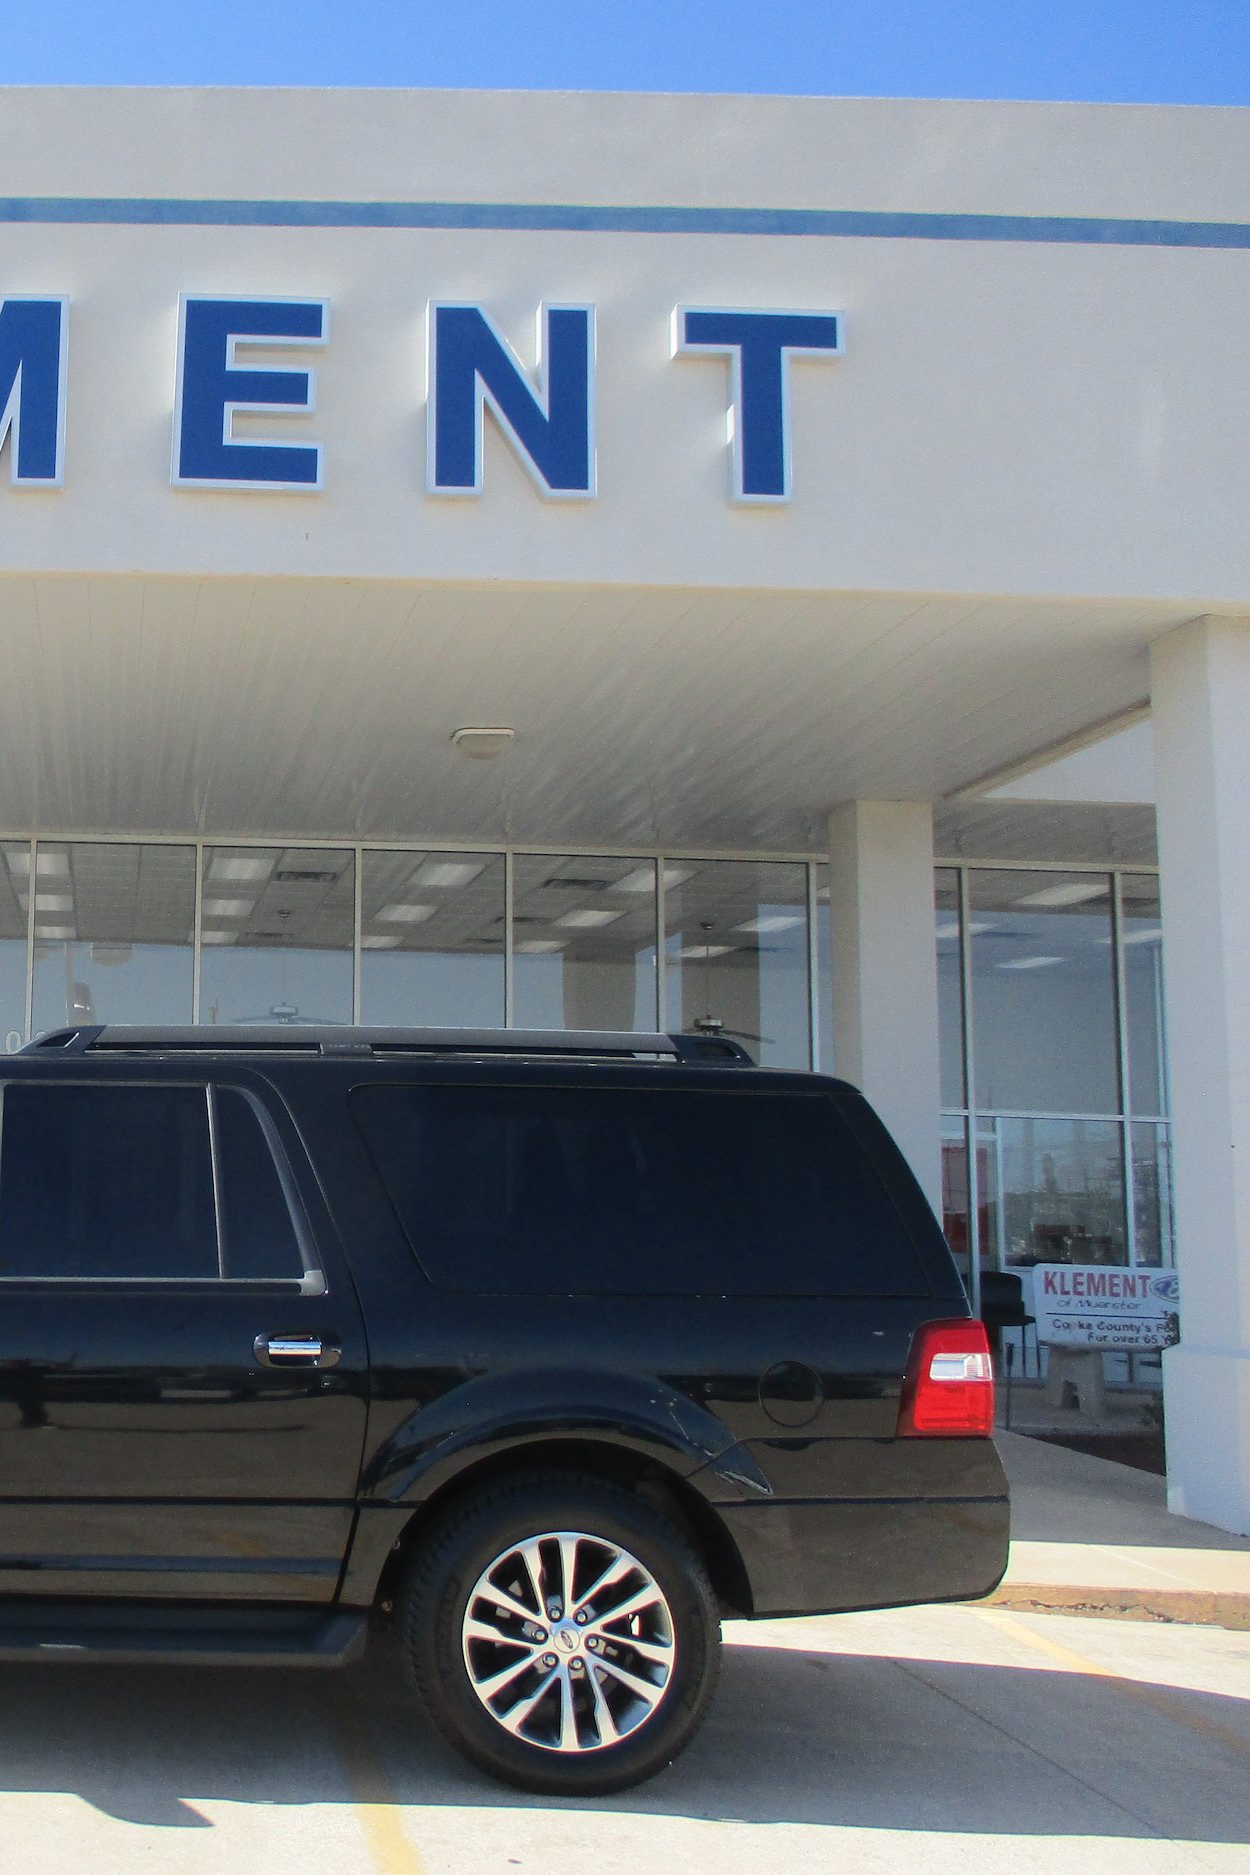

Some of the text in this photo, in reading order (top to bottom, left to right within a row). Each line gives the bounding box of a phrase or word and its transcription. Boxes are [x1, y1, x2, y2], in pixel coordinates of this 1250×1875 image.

[1043, 1270, 1151, 1298] KLEMENT
[1052, 1318, 1093, 1330] Coke
[1097, 1320, 1151, 1333] County's
[1112, 1335, 1139, 1344] over
